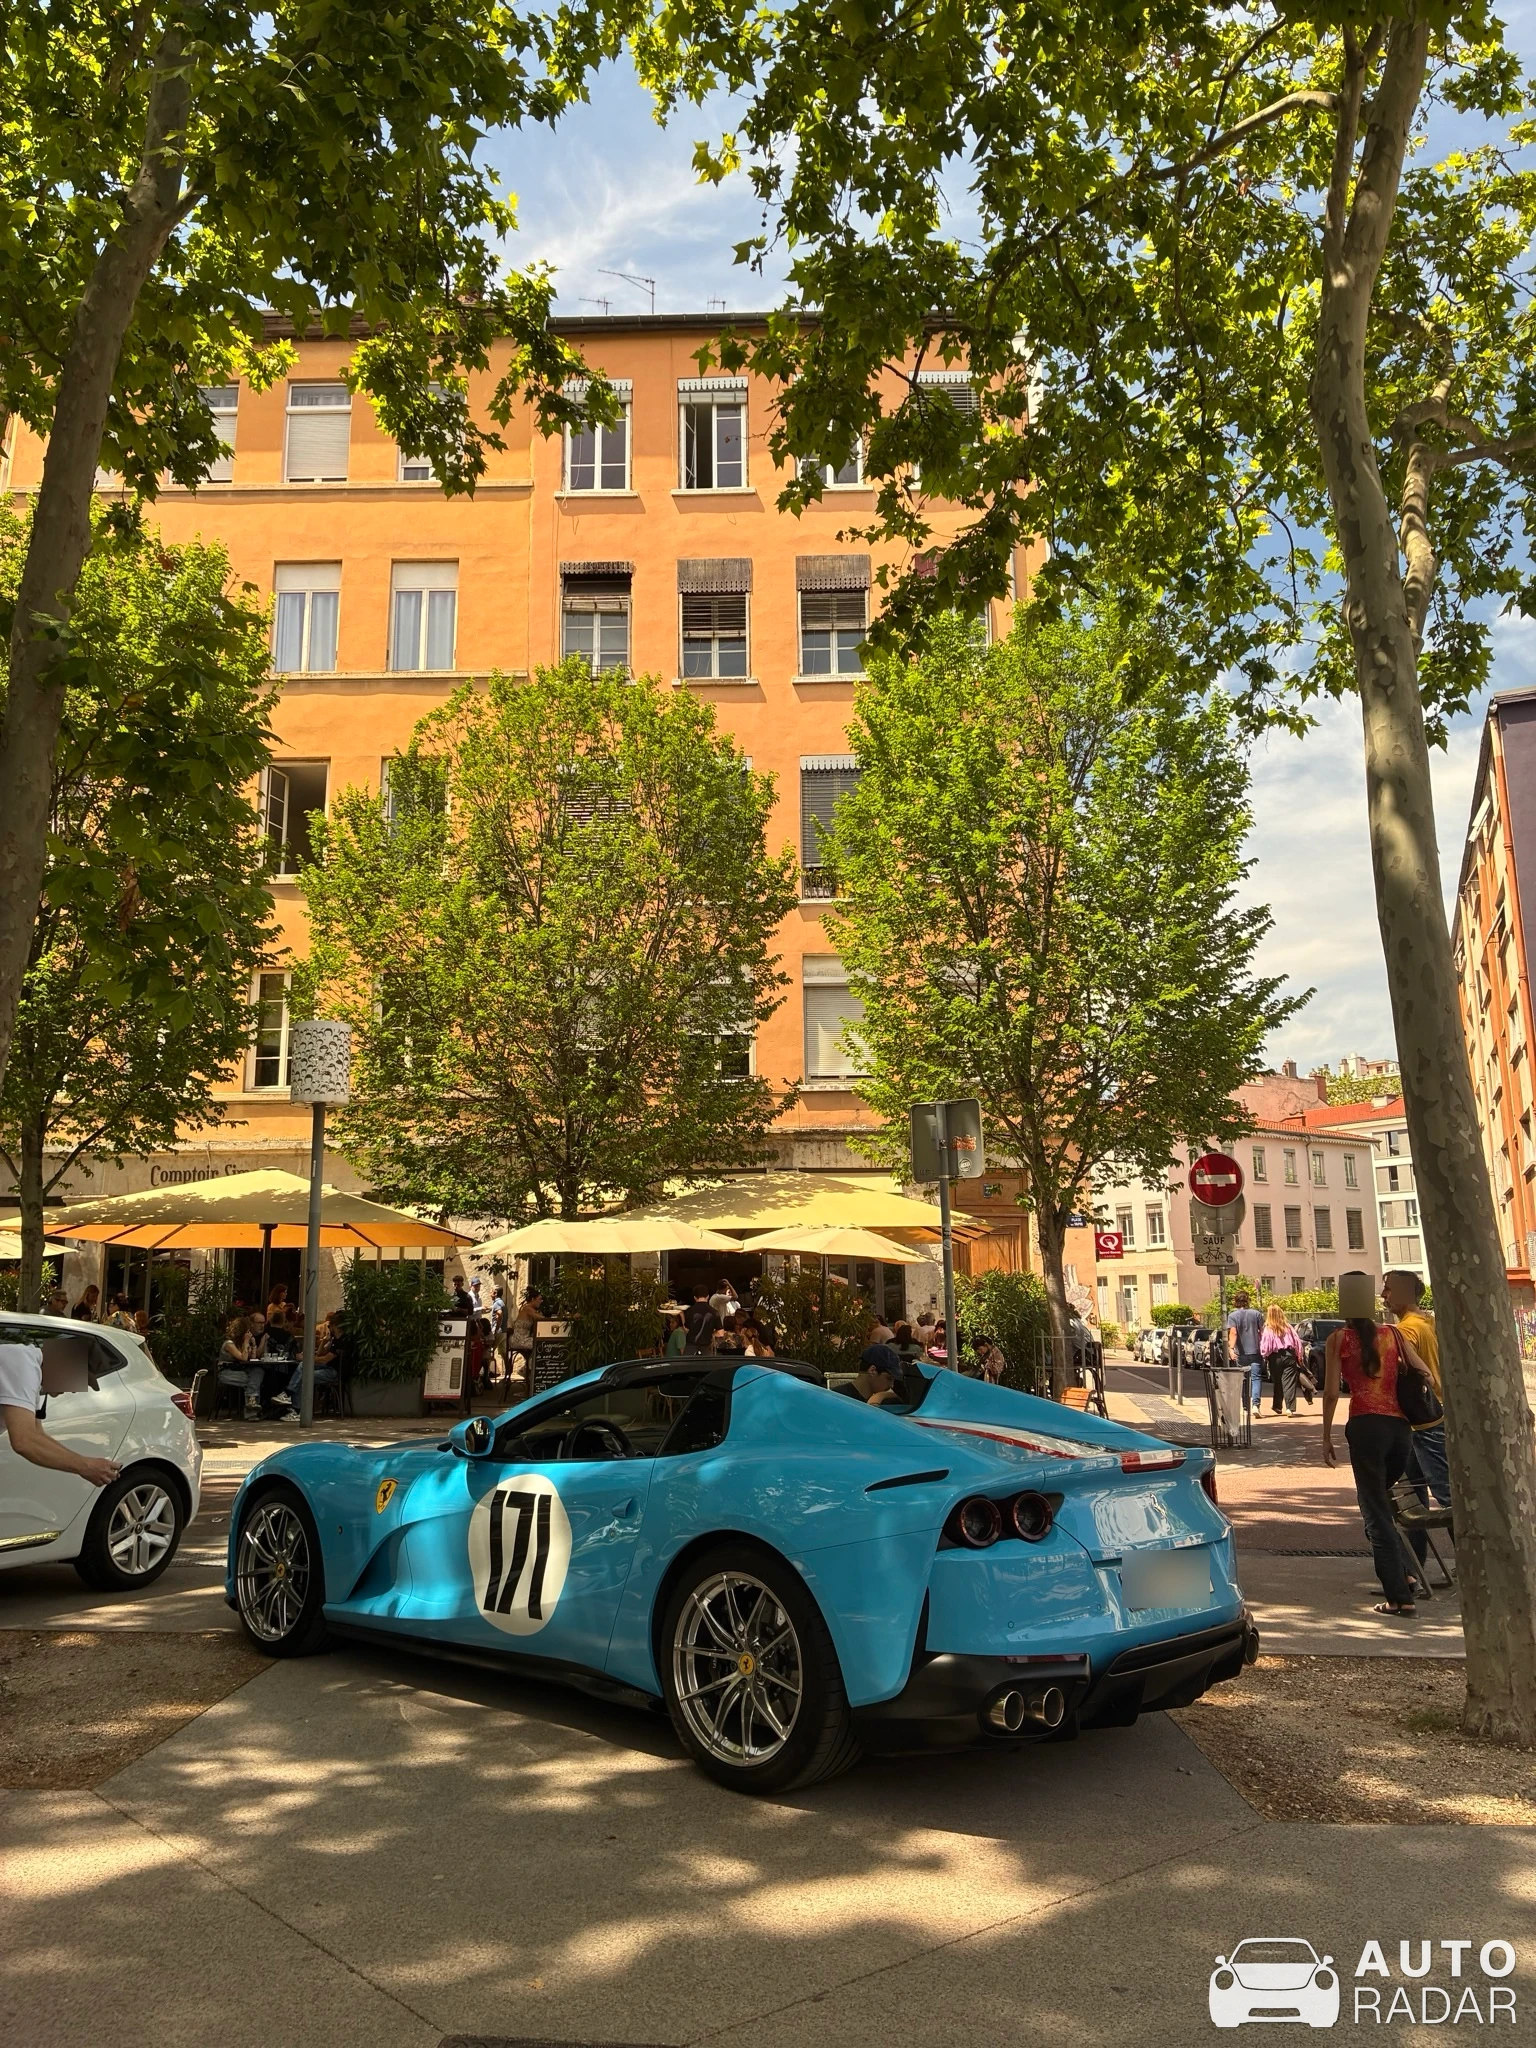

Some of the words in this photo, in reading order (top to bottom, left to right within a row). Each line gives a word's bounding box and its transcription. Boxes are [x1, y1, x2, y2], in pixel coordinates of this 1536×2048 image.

[151, 1165, 219, 1187] Comptoir
[1099, 1234, 1119, 1250] Q
[1203, 1236, 1225, 1245] SAUF
[483, 1489, 552, 1620] 171
